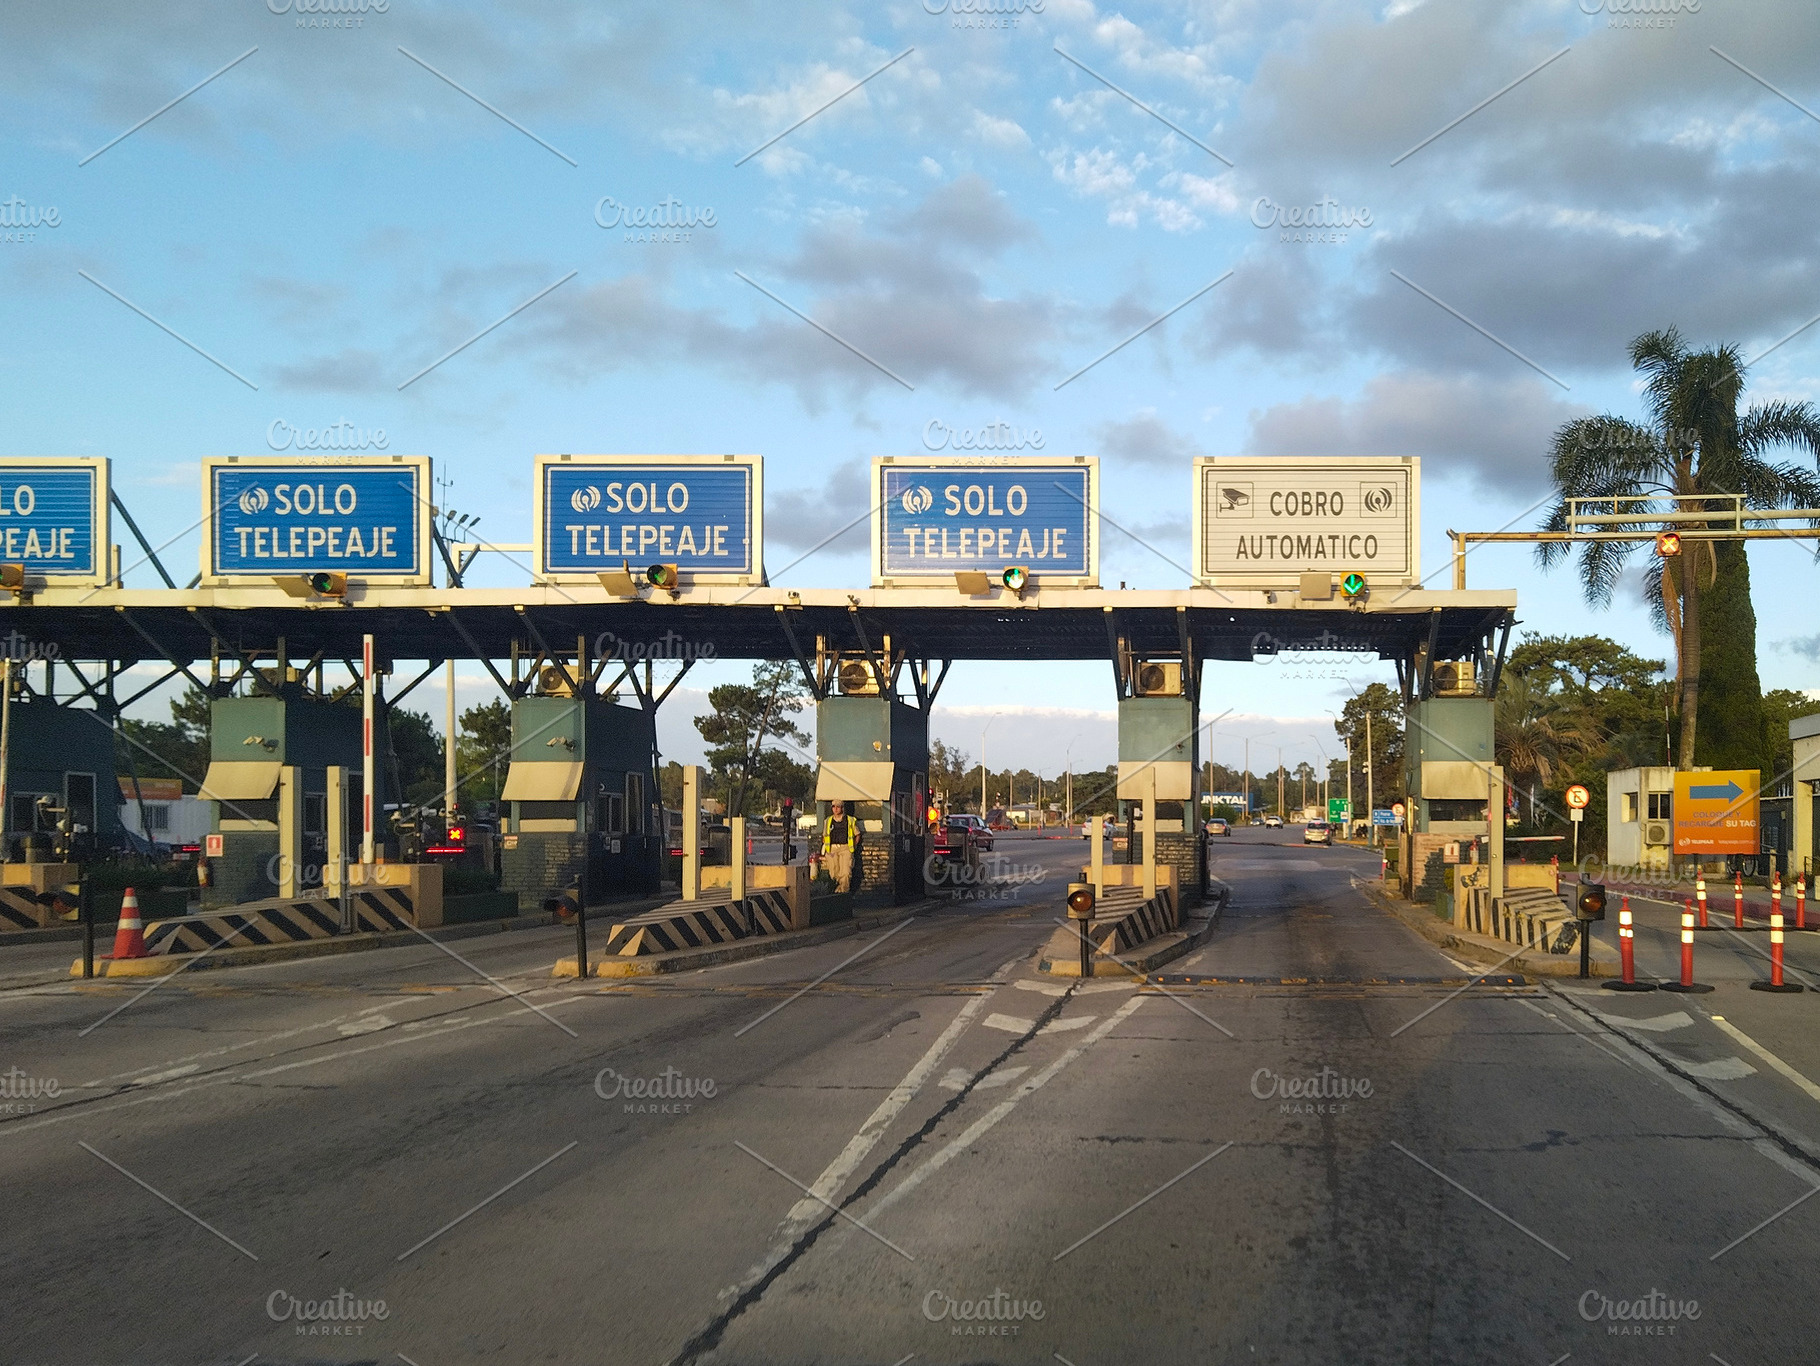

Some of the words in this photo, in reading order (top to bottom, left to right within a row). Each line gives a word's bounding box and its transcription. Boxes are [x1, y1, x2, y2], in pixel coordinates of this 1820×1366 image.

[274, 484, 357, 515] SOLO
[606, 482, 689, 513] SOLO
[944, 484, 1028, 516] SOLO
[1270, 491, 1344, 516] COBRO
[0, 528, 75, 558] EAJE
[234, 527, 397, 558] TELEPEAJE
[565, 525, 729, 556] TELEPEAJE
[903, 528, 1067, 558] TELEPEAJE
[1236, 534, 1378, 560] AUTOMATICO
